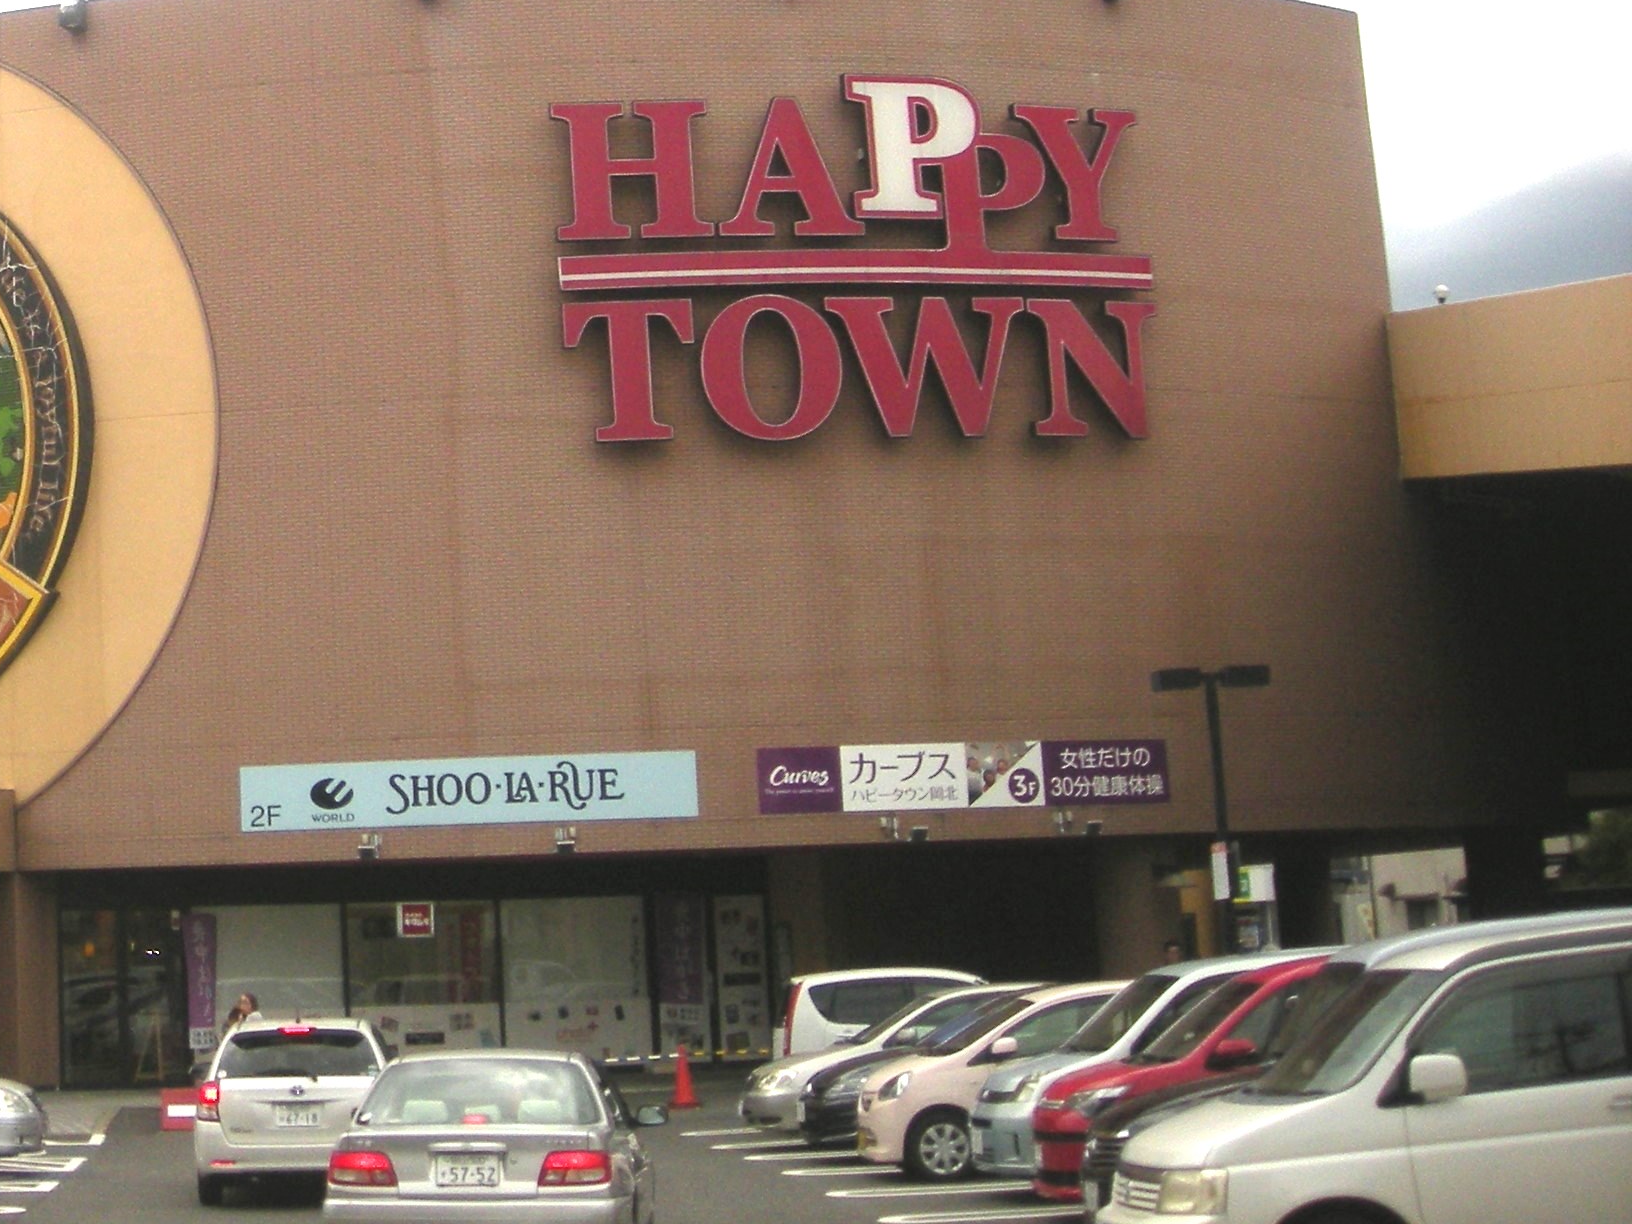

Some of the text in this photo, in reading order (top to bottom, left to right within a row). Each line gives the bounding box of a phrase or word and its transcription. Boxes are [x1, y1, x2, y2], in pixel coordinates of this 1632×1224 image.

[549, 74, 1137, 252] HAPPY
[562, 294, 1157, 442] TOWN
[849, 751, 956, 784] カーブス
[1060, 746, 1150, 769] 女性だけの
[770, 765, 829, 786] Curves
[1014, 775, 1036, 797] 3F
[1051, 774, 1164, 796] 30分健康体操
[251, 805, 281, 827] 2F
[312, 812, 355, 823] WORLD
